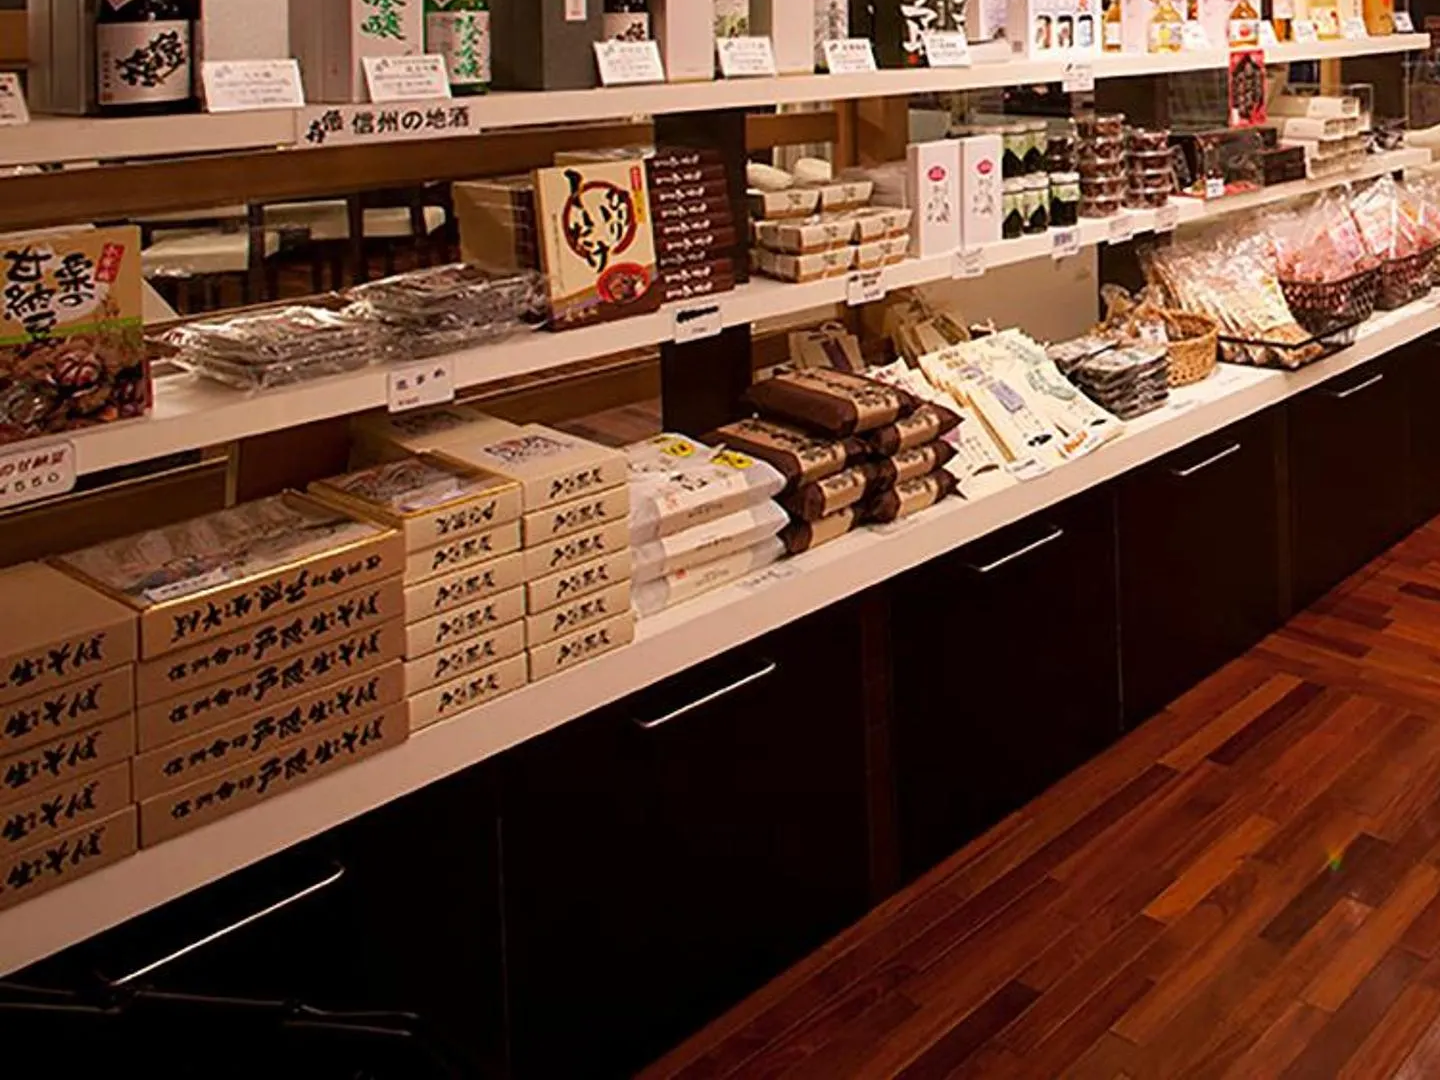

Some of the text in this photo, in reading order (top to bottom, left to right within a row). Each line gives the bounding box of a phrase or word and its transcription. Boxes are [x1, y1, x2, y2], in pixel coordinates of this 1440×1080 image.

[352, 107, 470, 134] 信州の地酒
